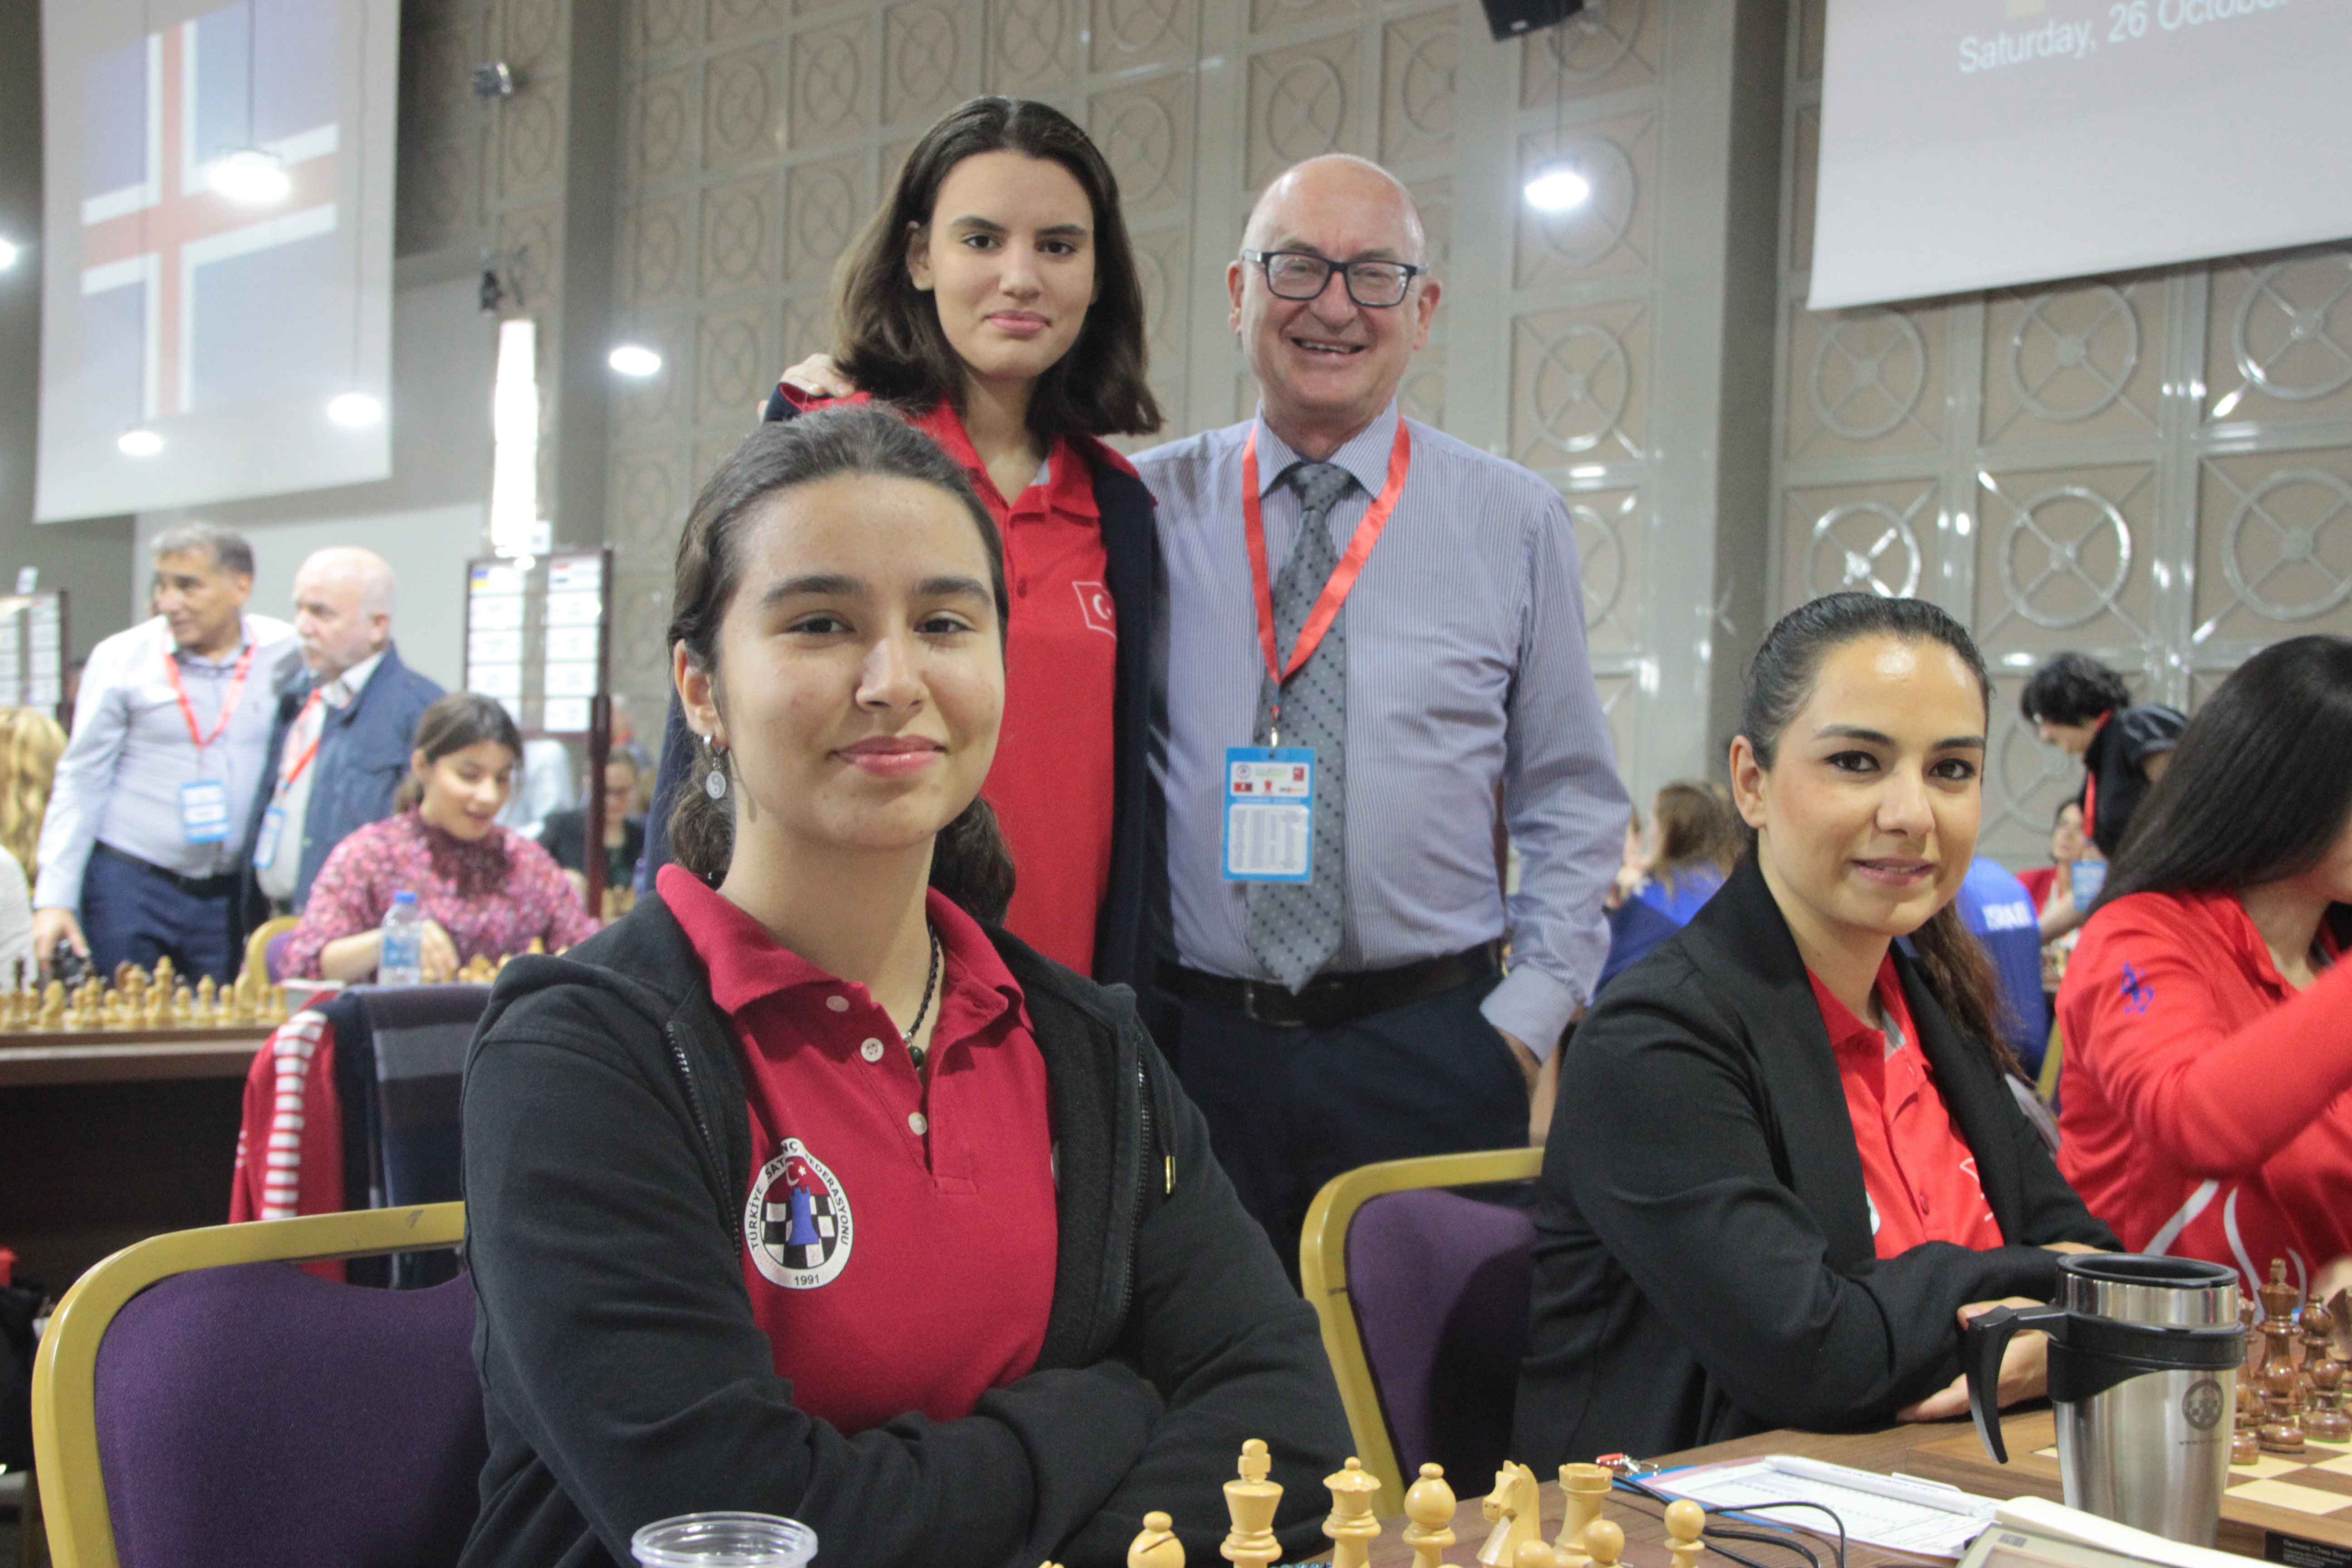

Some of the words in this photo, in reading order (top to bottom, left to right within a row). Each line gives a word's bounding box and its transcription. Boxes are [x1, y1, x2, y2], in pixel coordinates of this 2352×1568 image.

[1958, 19, 2097, 74] Saturday,
[2107, 1, 2148, 43] 26
[748, 1185, 763, 1251] TÜRKİYE
[794, 1274, 820, 1286] 1991
